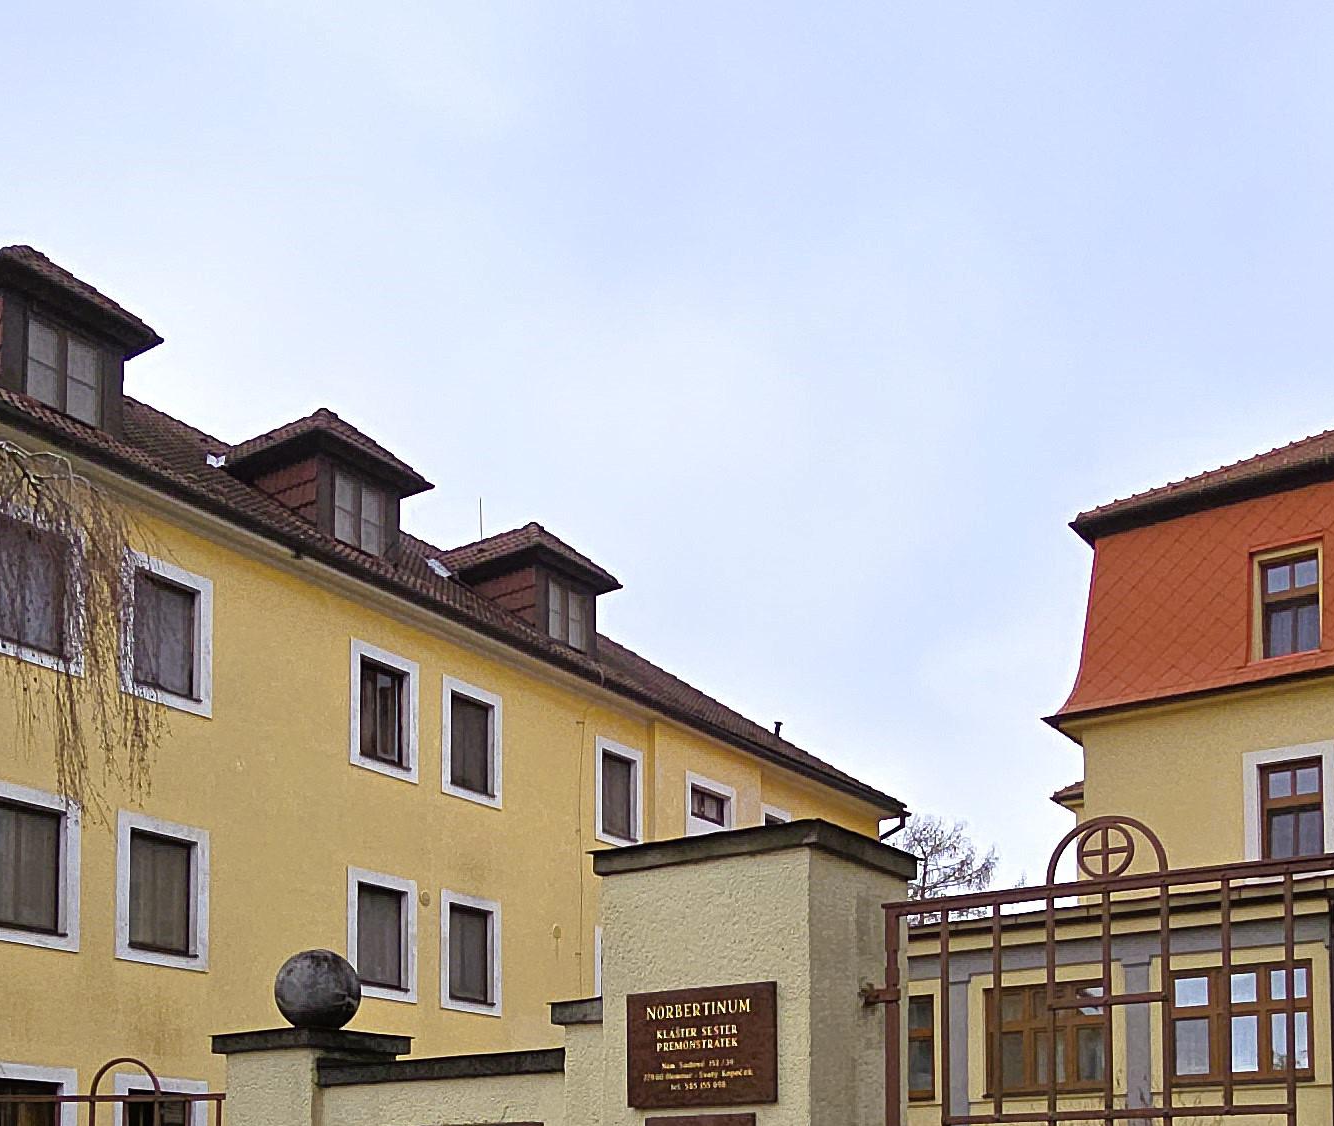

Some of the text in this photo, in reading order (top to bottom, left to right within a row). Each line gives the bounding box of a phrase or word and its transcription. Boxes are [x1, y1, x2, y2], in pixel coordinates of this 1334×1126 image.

[646, 998, 750, 1020] NORBERTINUM
[656, 1024, 738, 1039] KLÁŠTER SESTER
